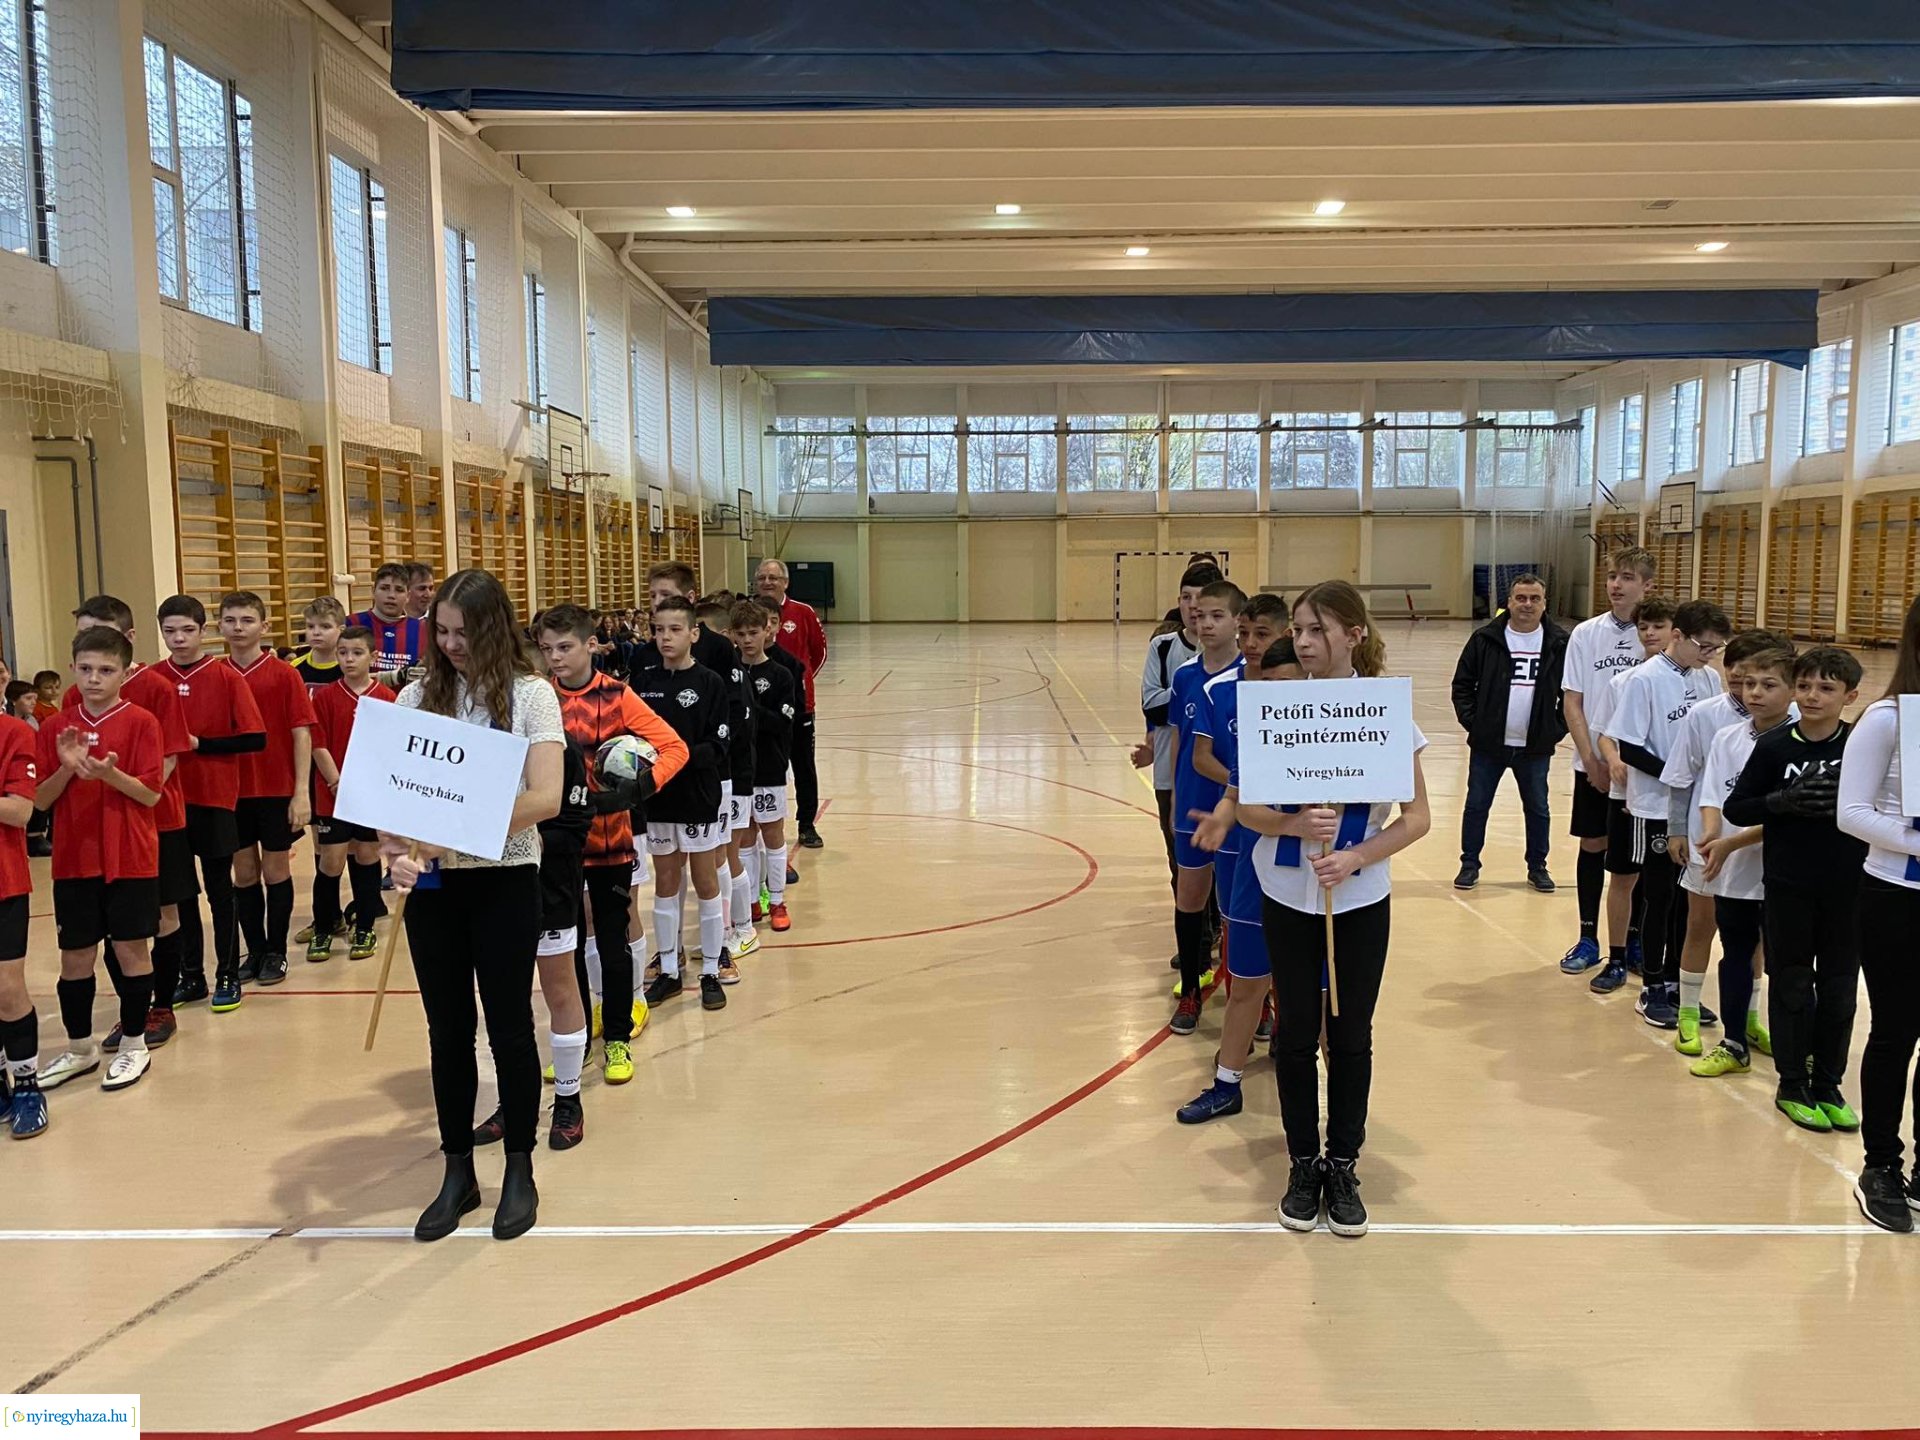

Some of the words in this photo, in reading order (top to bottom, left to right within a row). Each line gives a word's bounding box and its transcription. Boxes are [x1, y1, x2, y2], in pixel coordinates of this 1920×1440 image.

[1260, 703, 1314, 720] Petőfi
[1320, 702, 1387, 719] Sándor
[1259, 726, 1390, 748] Tagintézmény
[405, 735, 465, 765] FILO
[1286, 766, 1364, 780] Nyíregyháza
[389, 774, 464, 803] Nyíregyháza
[569, 785, 588, 806] 81
[754, 793, 777, 812] 82
[685, 823, 711, 838] 87
